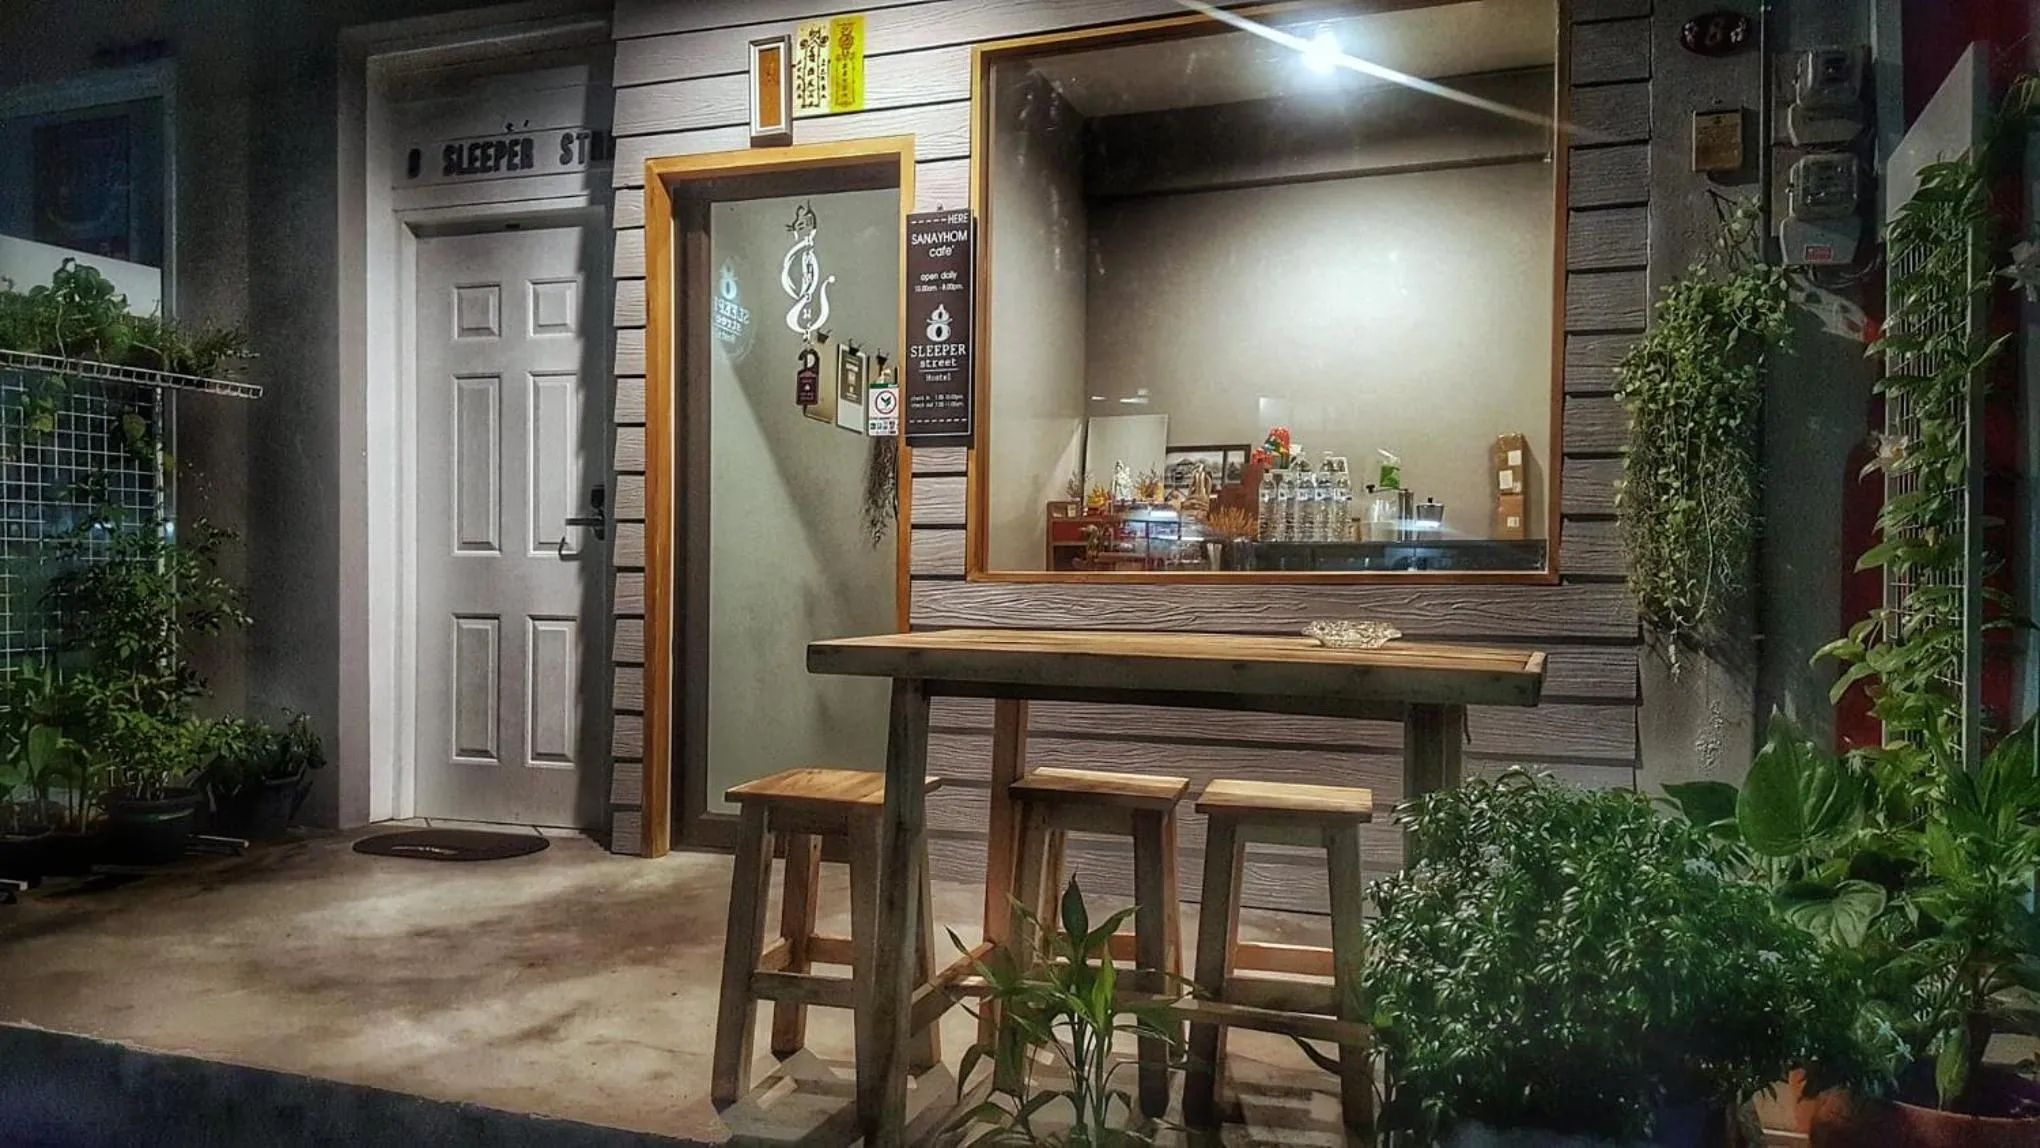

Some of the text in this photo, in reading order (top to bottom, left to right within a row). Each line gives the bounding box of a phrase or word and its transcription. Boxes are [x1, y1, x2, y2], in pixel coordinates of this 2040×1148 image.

[442, 137, 534, 177] SLEEPER
[948, 213, 969, 224] HERE
[911, 230, 968, 245] SANAYHOM
[920, 270, 957, 282] open daily
[911, 344, 967, 358] SLEEPER
[920, 358, 957, 368] street
